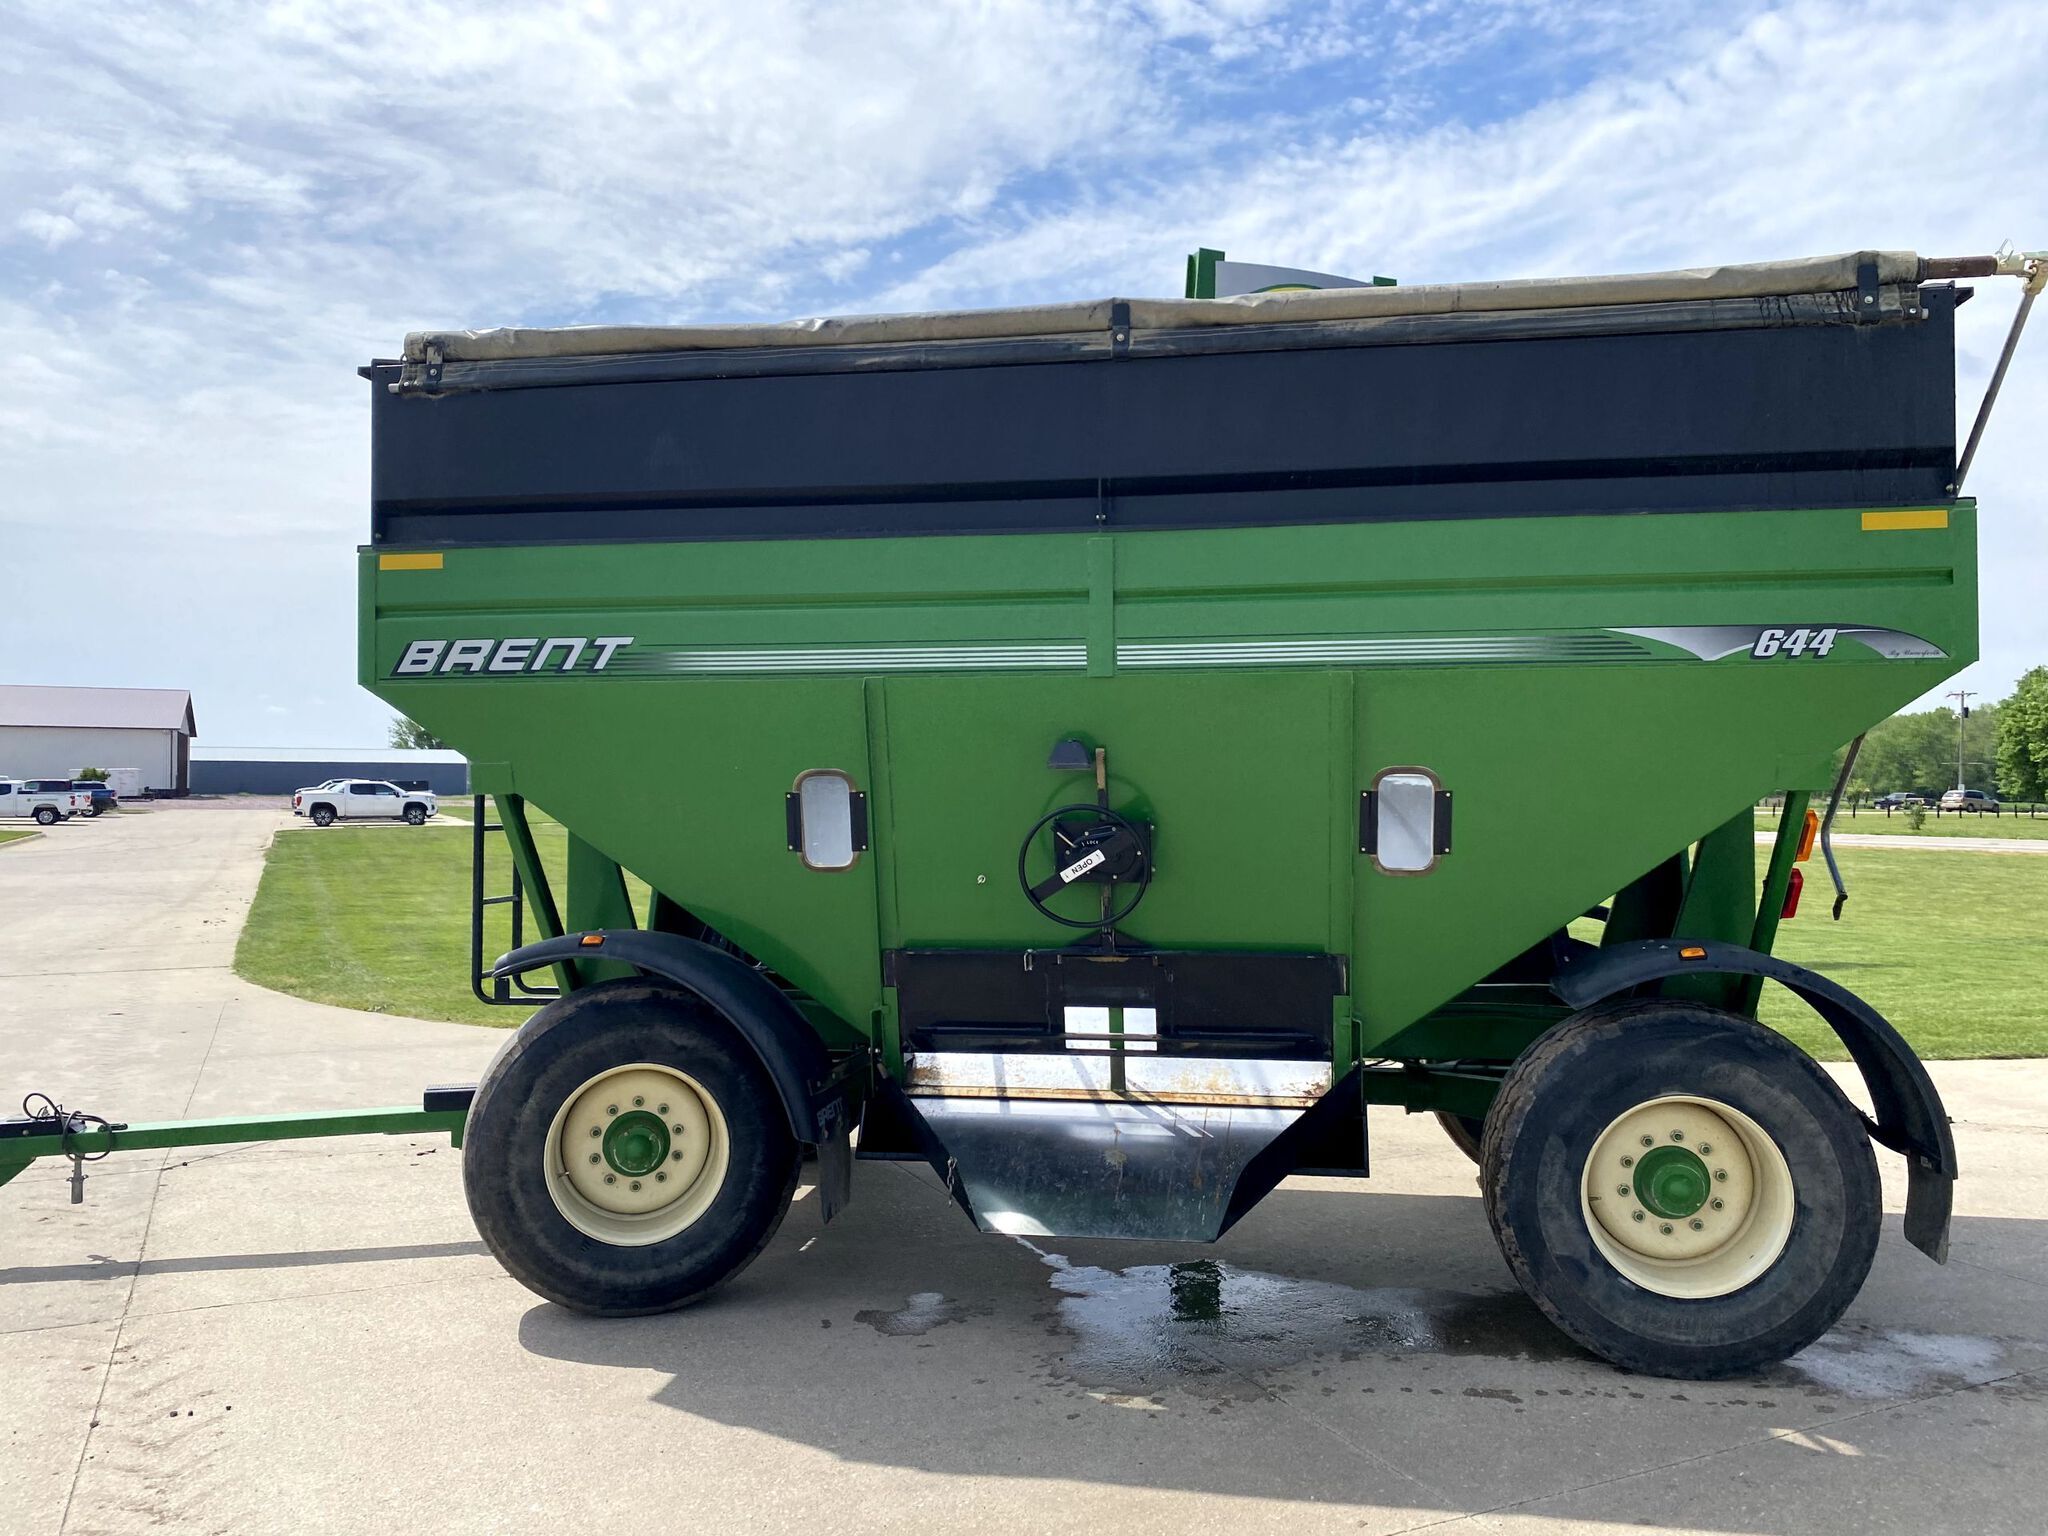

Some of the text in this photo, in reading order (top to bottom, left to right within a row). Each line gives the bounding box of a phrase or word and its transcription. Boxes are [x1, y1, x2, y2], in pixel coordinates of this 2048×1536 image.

[392, 636, 635, 674] BRENT
[1753, 628, 1838, 658] 644
[1071, 858, 1093, 875] OPEN
